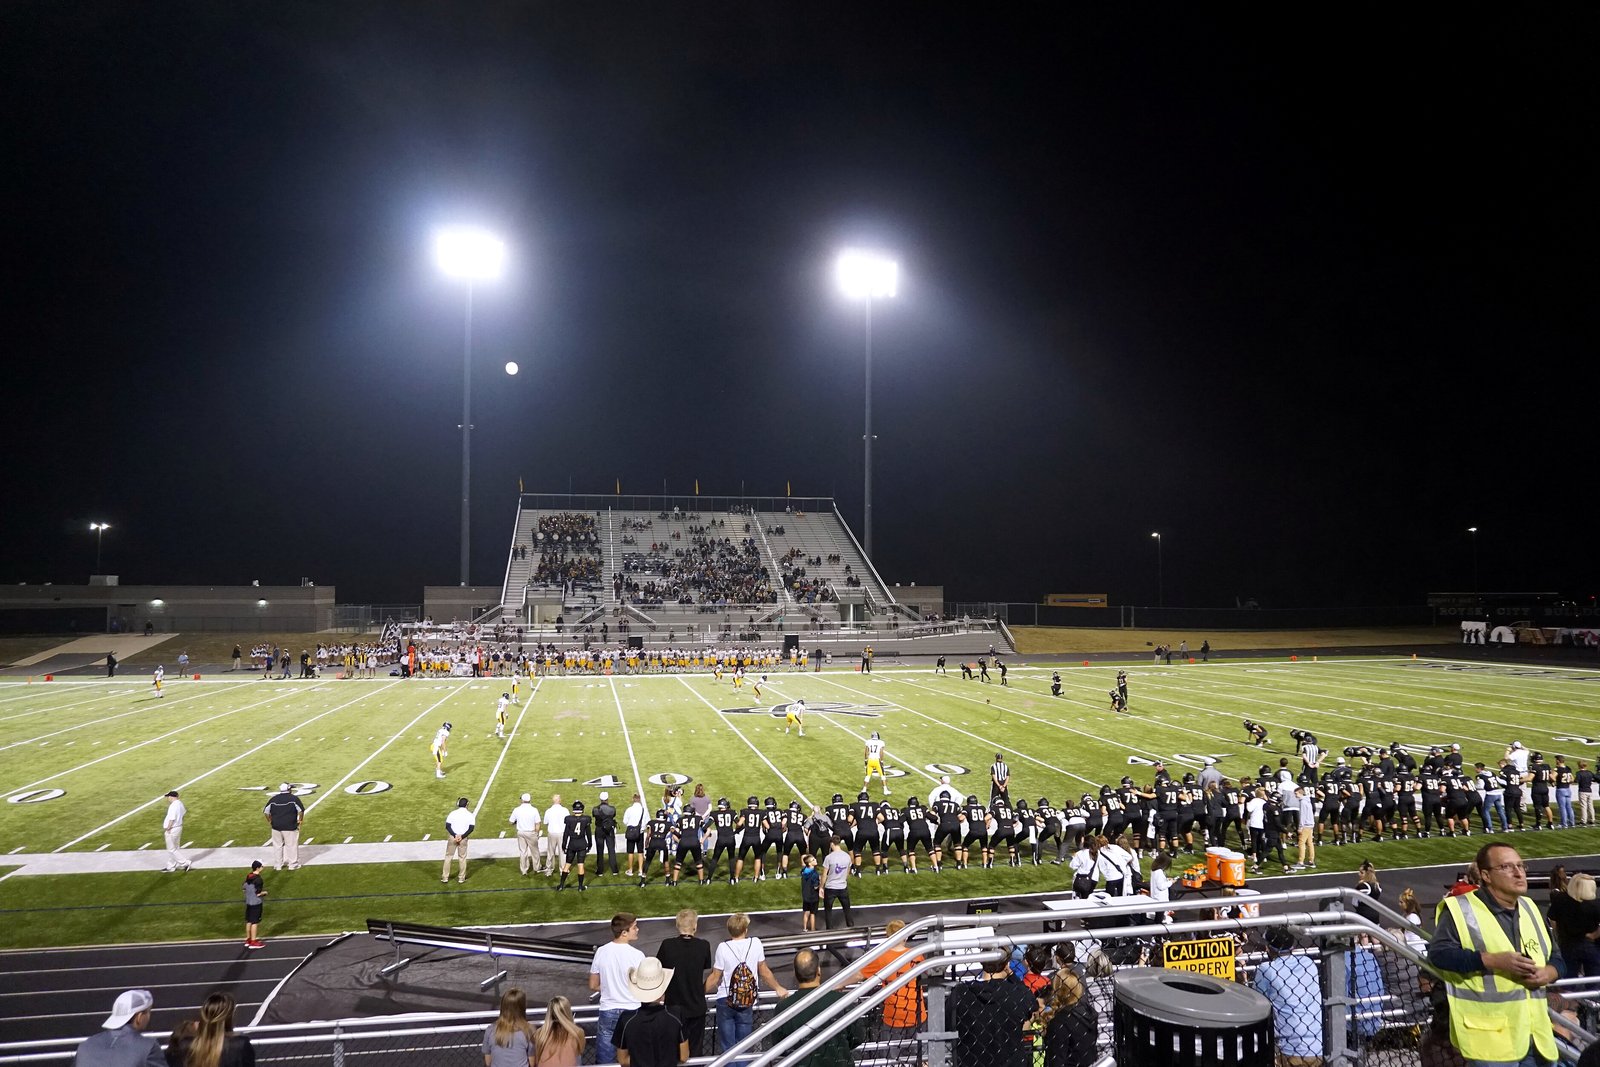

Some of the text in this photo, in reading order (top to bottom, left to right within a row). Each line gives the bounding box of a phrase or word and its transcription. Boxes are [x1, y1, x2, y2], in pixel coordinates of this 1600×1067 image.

[1497, 607, 1531, 616] CITY
[870, 744, 878, 754] 17
[1542, 769, 1550, 781] 11
[1265, 781, 1277, 793] 42
[1327, 783, 1339, 795] 31
[1367, 780, 1374, 792] 7
[1124, 791, 1138, 804] 75
[1165, 791, 1177, 804] 79
[1227, 791, 1239, 805] 16
[942, 802, 955, 814] 77
[1087, 799, 1100, 811] 27
[768, 811, 782, 824] 82
[833, 808, 847, 821] 78
[860, 805, 874, 819] 74
[885, 808, 899, 821] 53
[909, 808, 924, 821] 65
[971, 808, 984, 821] 60
[1021, 808, 1035, 819] 34
[1045, 808, 1058, 819] 32
[682, 817, 696, 830] 54
[717, 813, 732, 828] 50
[748, 813, 760, 828] 91
[791, 812, 804, 826] 52
[574, 822, 581, 836] 4
[654, 823, 666, 834] 13
[1169, 941, 1230, 960] CAUTION
